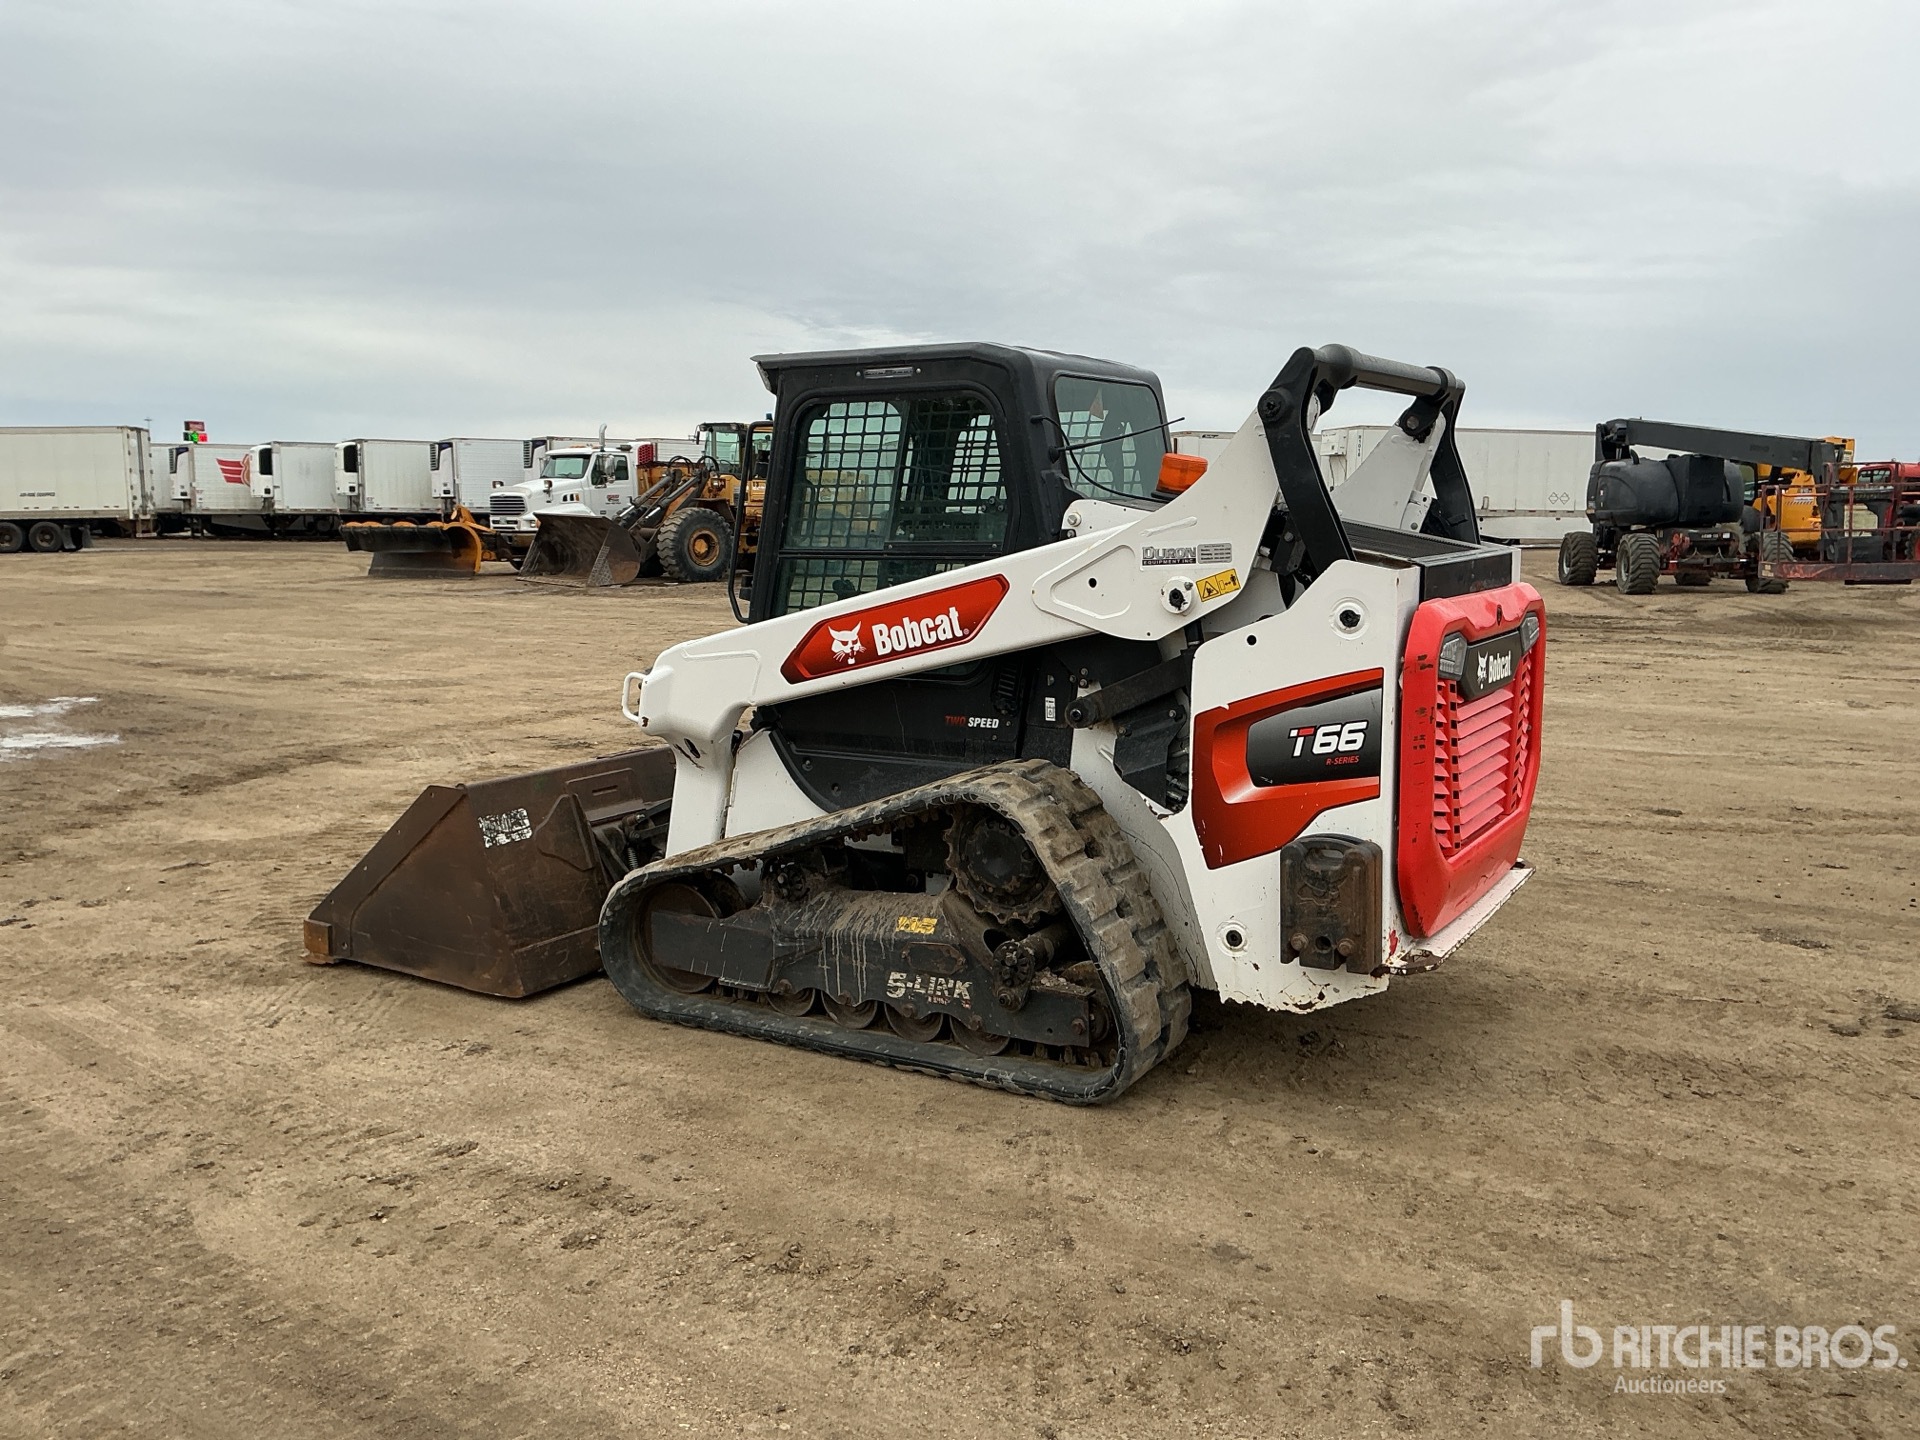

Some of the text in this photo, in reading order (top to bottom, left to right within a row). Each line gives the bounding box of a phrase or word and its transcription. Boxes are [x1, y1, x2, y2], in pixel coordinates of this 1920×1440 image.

[1142, 546, 1196, 559] DURON
[872, 606, 963, 656] Bobcat
[1488, 650, 1512, 684] Bobcat
[945, 715, 1000, 728] TWO SPEED
[1289, 721, 1368, 757] T66
[1325, 755, 1360, 766] R-SERIES
[886, 971, 973, 1000] 5-LINK
